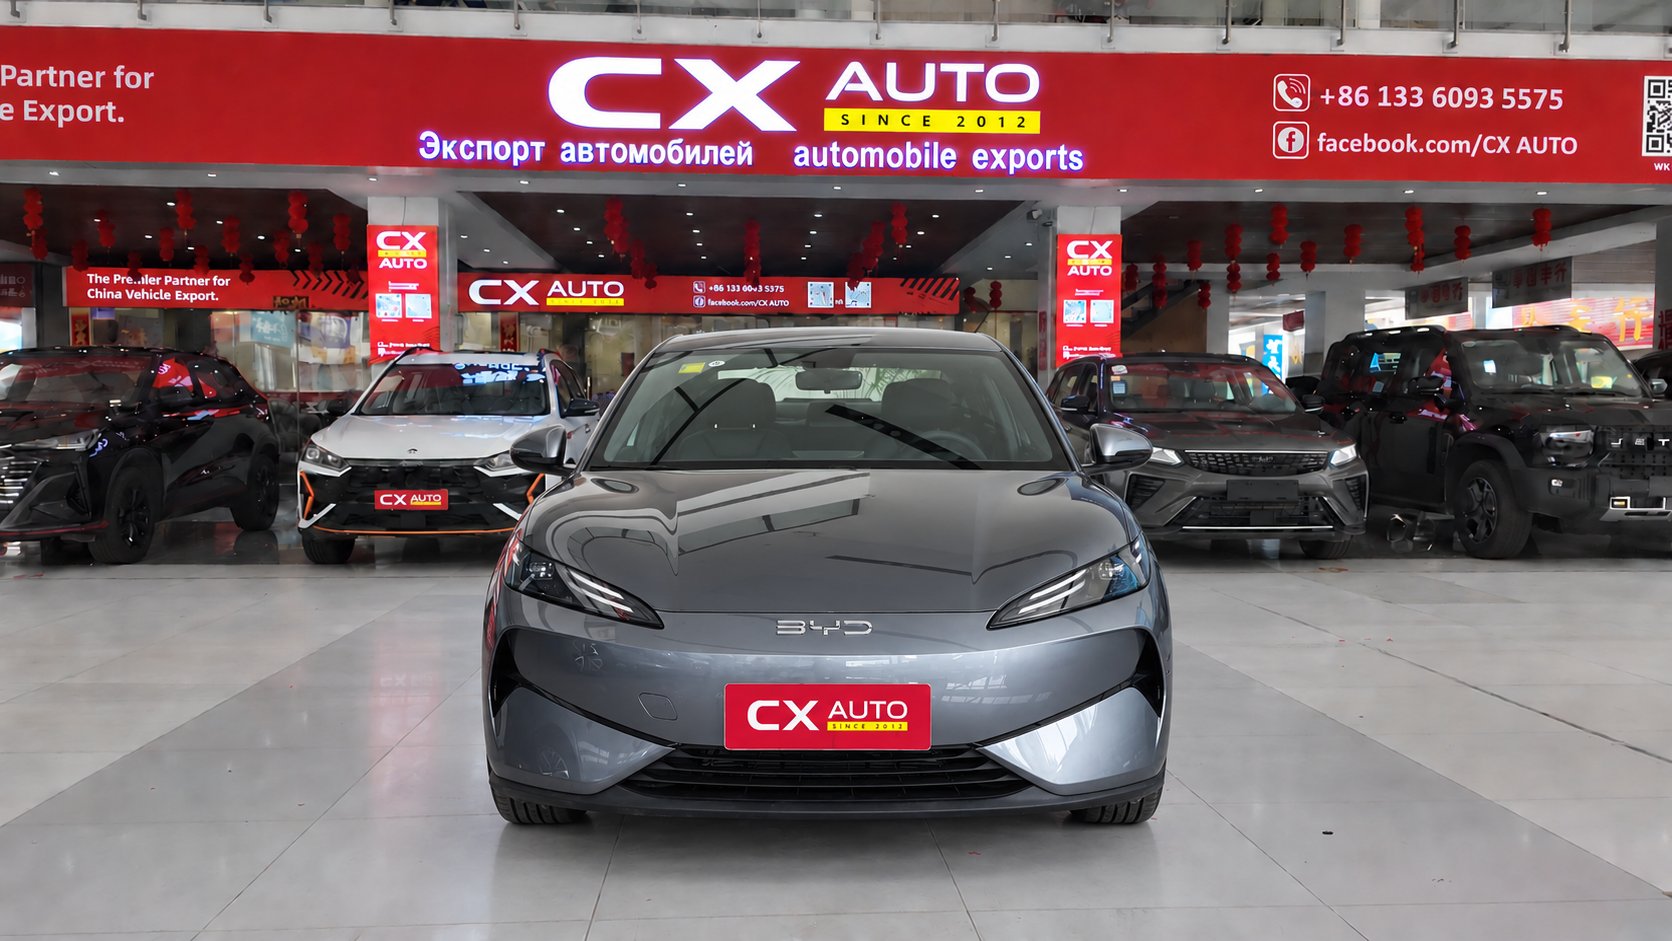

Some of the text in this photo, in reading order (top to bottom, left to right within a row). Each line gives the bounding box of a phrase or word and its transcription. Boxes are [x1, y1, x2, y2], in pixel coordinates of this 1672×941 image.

[0, 64, 155, 88] Partner for
[826, 61, 1041, 103] AUTO
[548, 57, 801, 132] CX
[1320, 86, 1563, 110] +86 133 6093 5575
[23, 100, 125, 128] Export.
[841, 114, 1026, 128] SINCE 2012
[418, 130, 754, 167] Экспорт автомобилей
[1317, 133, 1578, 158] facebook.com/CX AUTO
[793, 141, 1084, 175] automobile exports
[376, 231, 427, 250] CX
[1066, 240, 1113, 259] CX
[378, 258, 428, 269] AUTO
[1067, 265, 1113, 276] AUTO
[87, 274, 110, 285] The
[164, 275, 210, 287] Partner
[212, 275, 231, 287] for
[547, 280, 625, 297] AUTO
[708, 284, 724, 292] +86
[87, 288, 219, 303] China Vehicle Export.
[468, 279, 540, 306] CX
[769, 299, 790, 307] AUTO
[379, 493, 442, 506] CX AUTO
[776, 619, 873, 636] BYD
[747, 699, 820, 731] CX
[827, 700, 909, 720] AUTO
